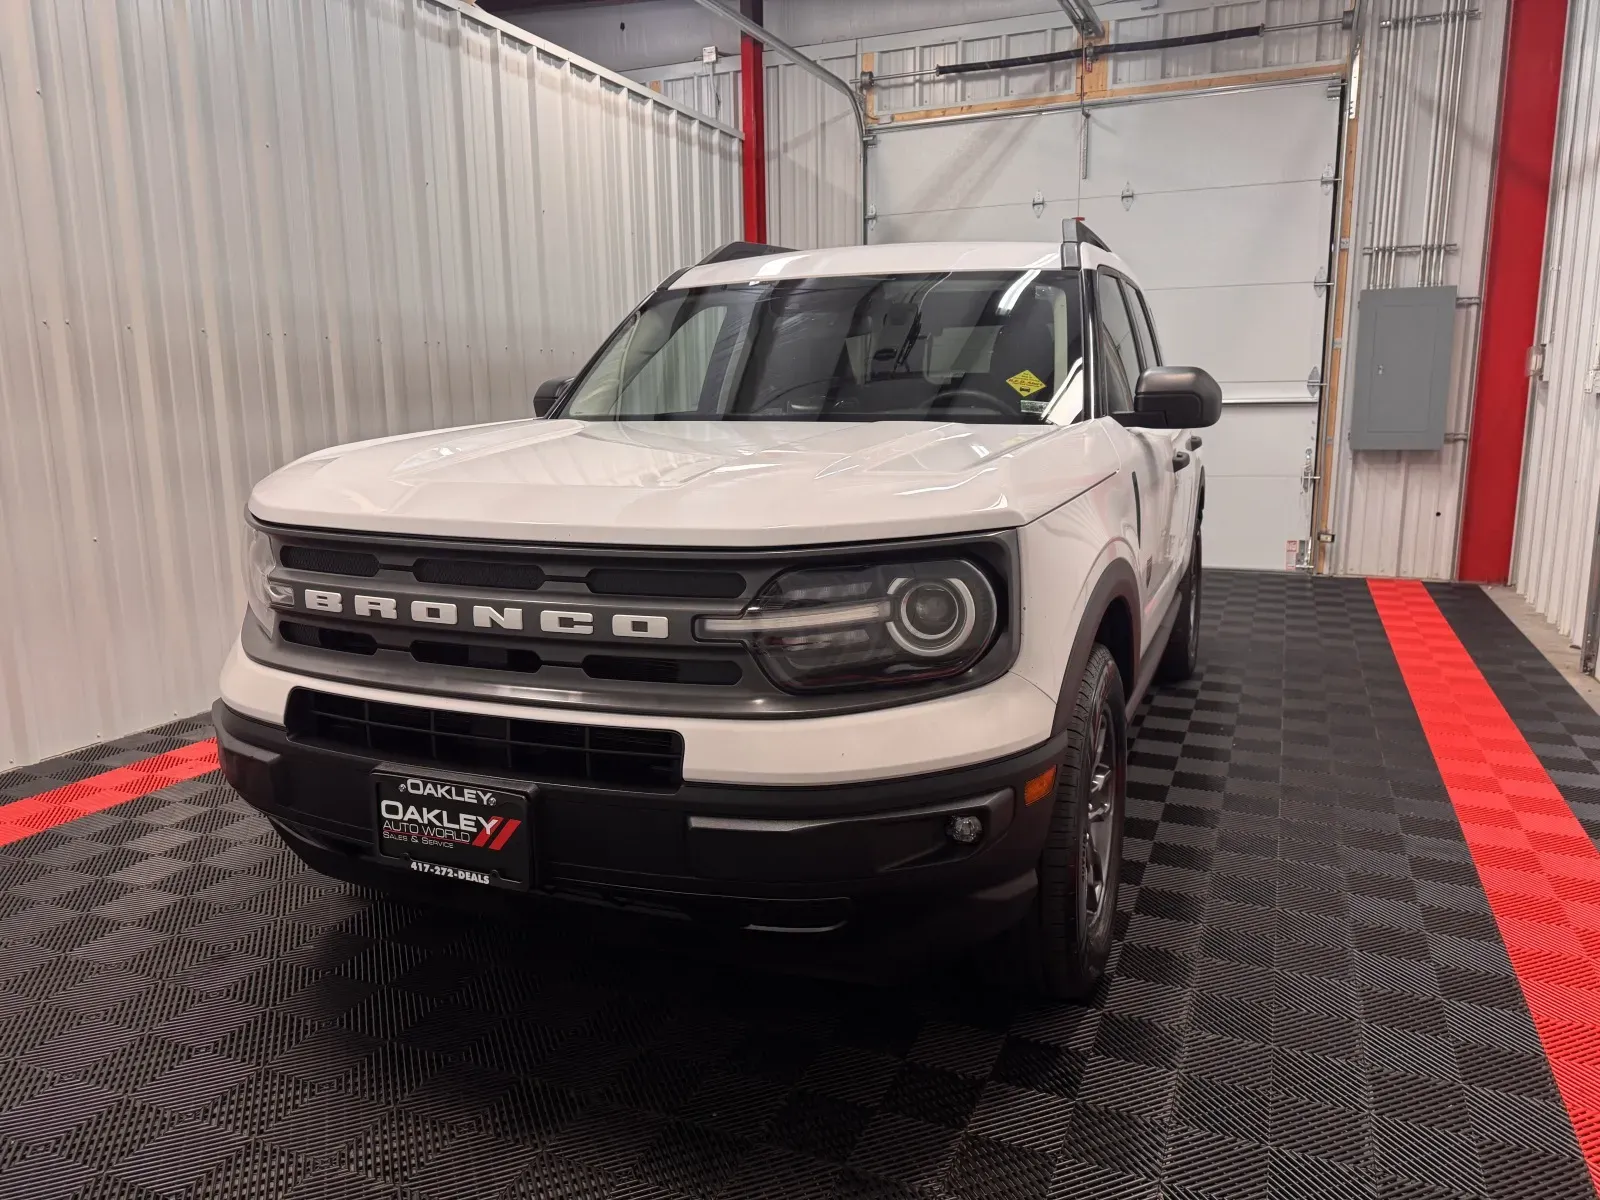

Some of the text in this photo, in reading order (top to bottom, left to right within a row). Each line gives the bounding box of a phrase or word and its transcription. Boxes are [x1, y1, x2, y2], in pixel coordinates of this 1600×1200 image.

[304, 588, 669, 639] BRONCO
[406, 778, 492, 806] OAKLEY
[380, 799, 499, 835] OAKLEY
[382, 819, 471, 843] AUTO WORLD
[410, 835, 419, 843] &
[410, 861, 490, 885] 417-272-DEALS
